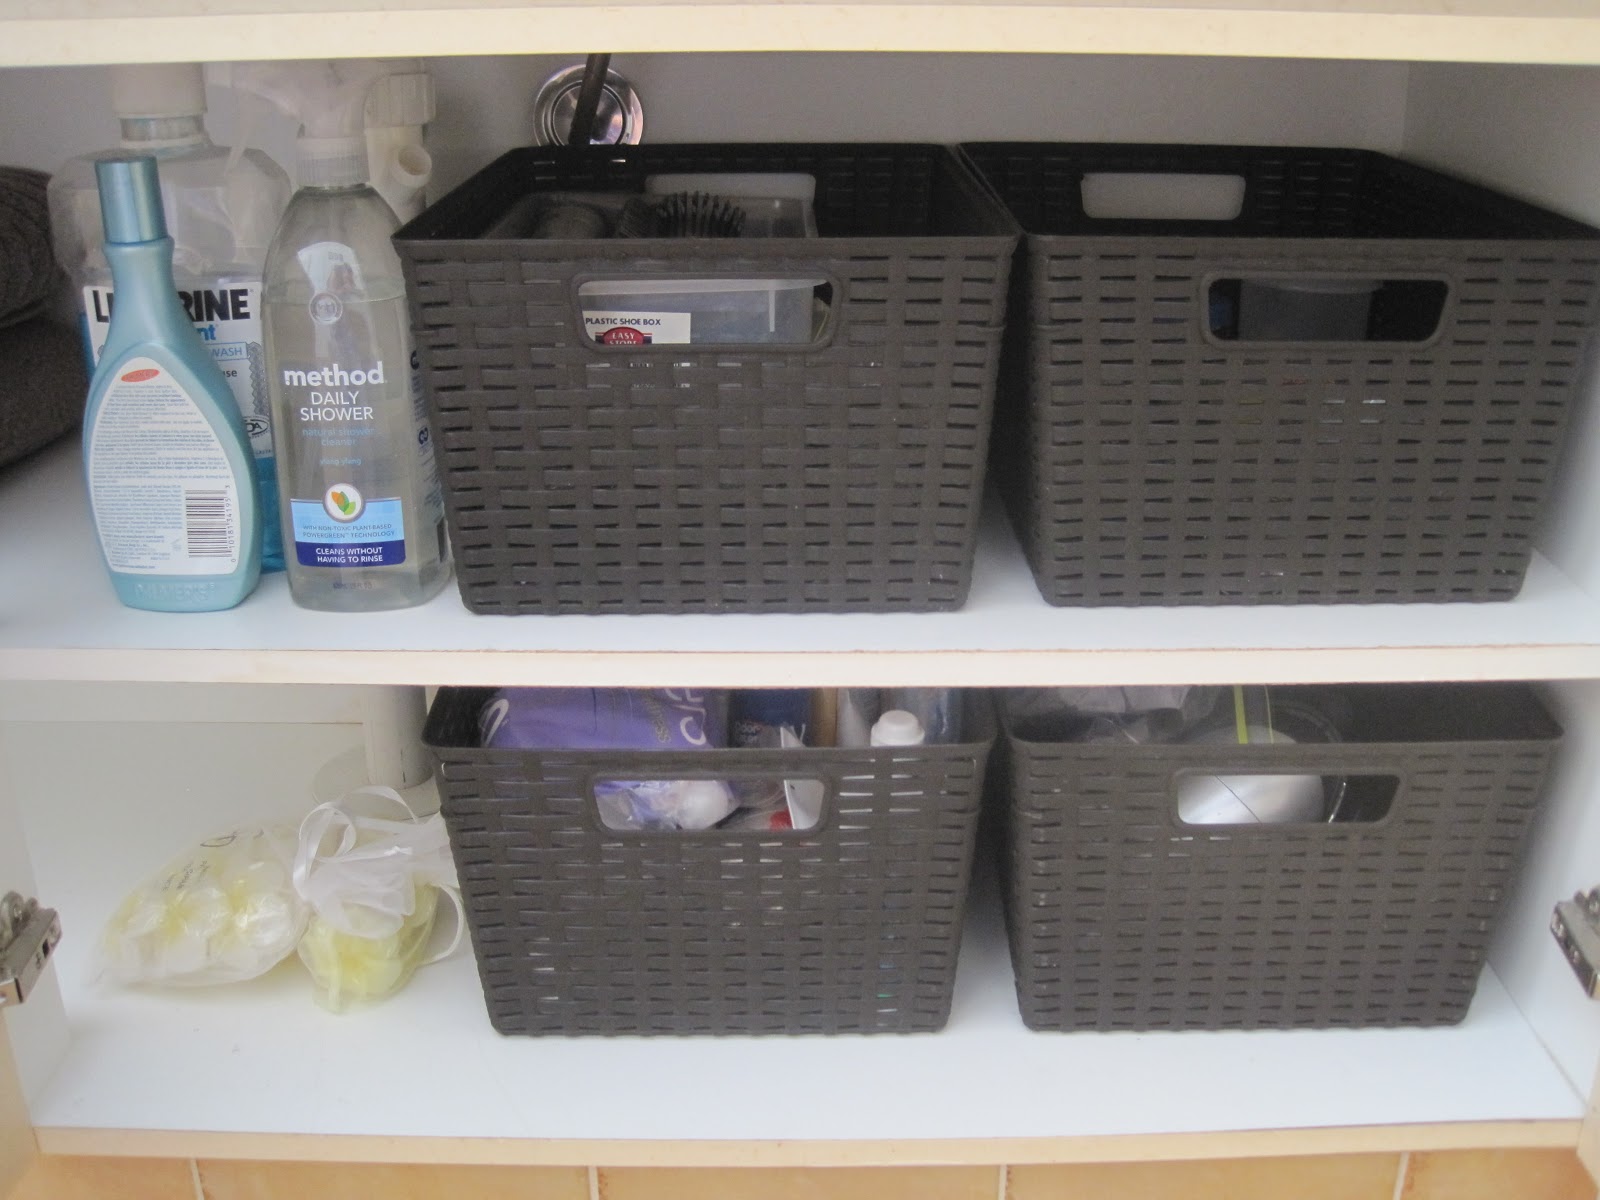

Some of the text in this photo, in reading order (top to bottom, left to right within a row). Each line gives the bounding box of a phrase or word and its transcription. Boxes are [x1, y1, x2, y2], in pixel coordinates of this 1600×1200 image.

[92, 288, 251, 324] LIRINE
[585, 317, 618, 325] PLASTIC
[642, 318, 662, 326] BOX
[612, 332, 636, 340] EASY
[283, 360, 385, 387] method
[311, 391, 360, 405] DAILY
[300, 406, 375, 421] SHOWER
[302, 427, 376, 437] natural shower
[321, 437, 356, 446] cleaner
[352, 523, 392, 531] PLANT-BASED
[351, 530, 395, 538] TECHNOLOGY
[316, 546, 383, 555] CLEANS WITHOUT
[360, 554, 383, 562] RINSE
